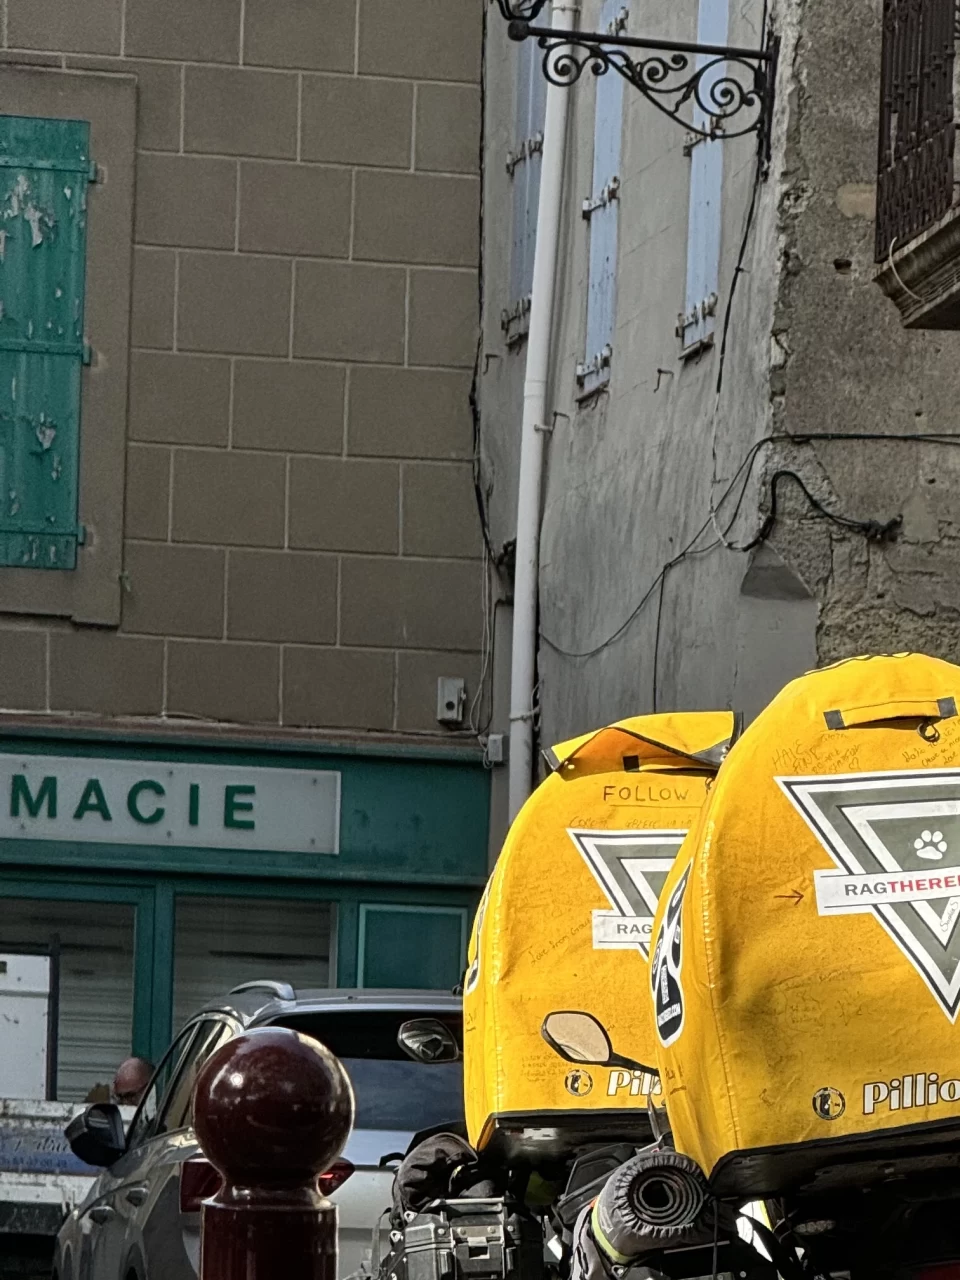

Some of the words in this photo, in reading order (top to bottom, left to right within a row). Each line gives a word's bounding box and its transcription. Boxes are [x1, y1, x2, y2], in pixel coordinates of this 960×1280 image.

[603, 785, 689, 802] FOLLOW
[10, 774, 256, 831] MACIE
[616, 923, 653, 935] RAG
